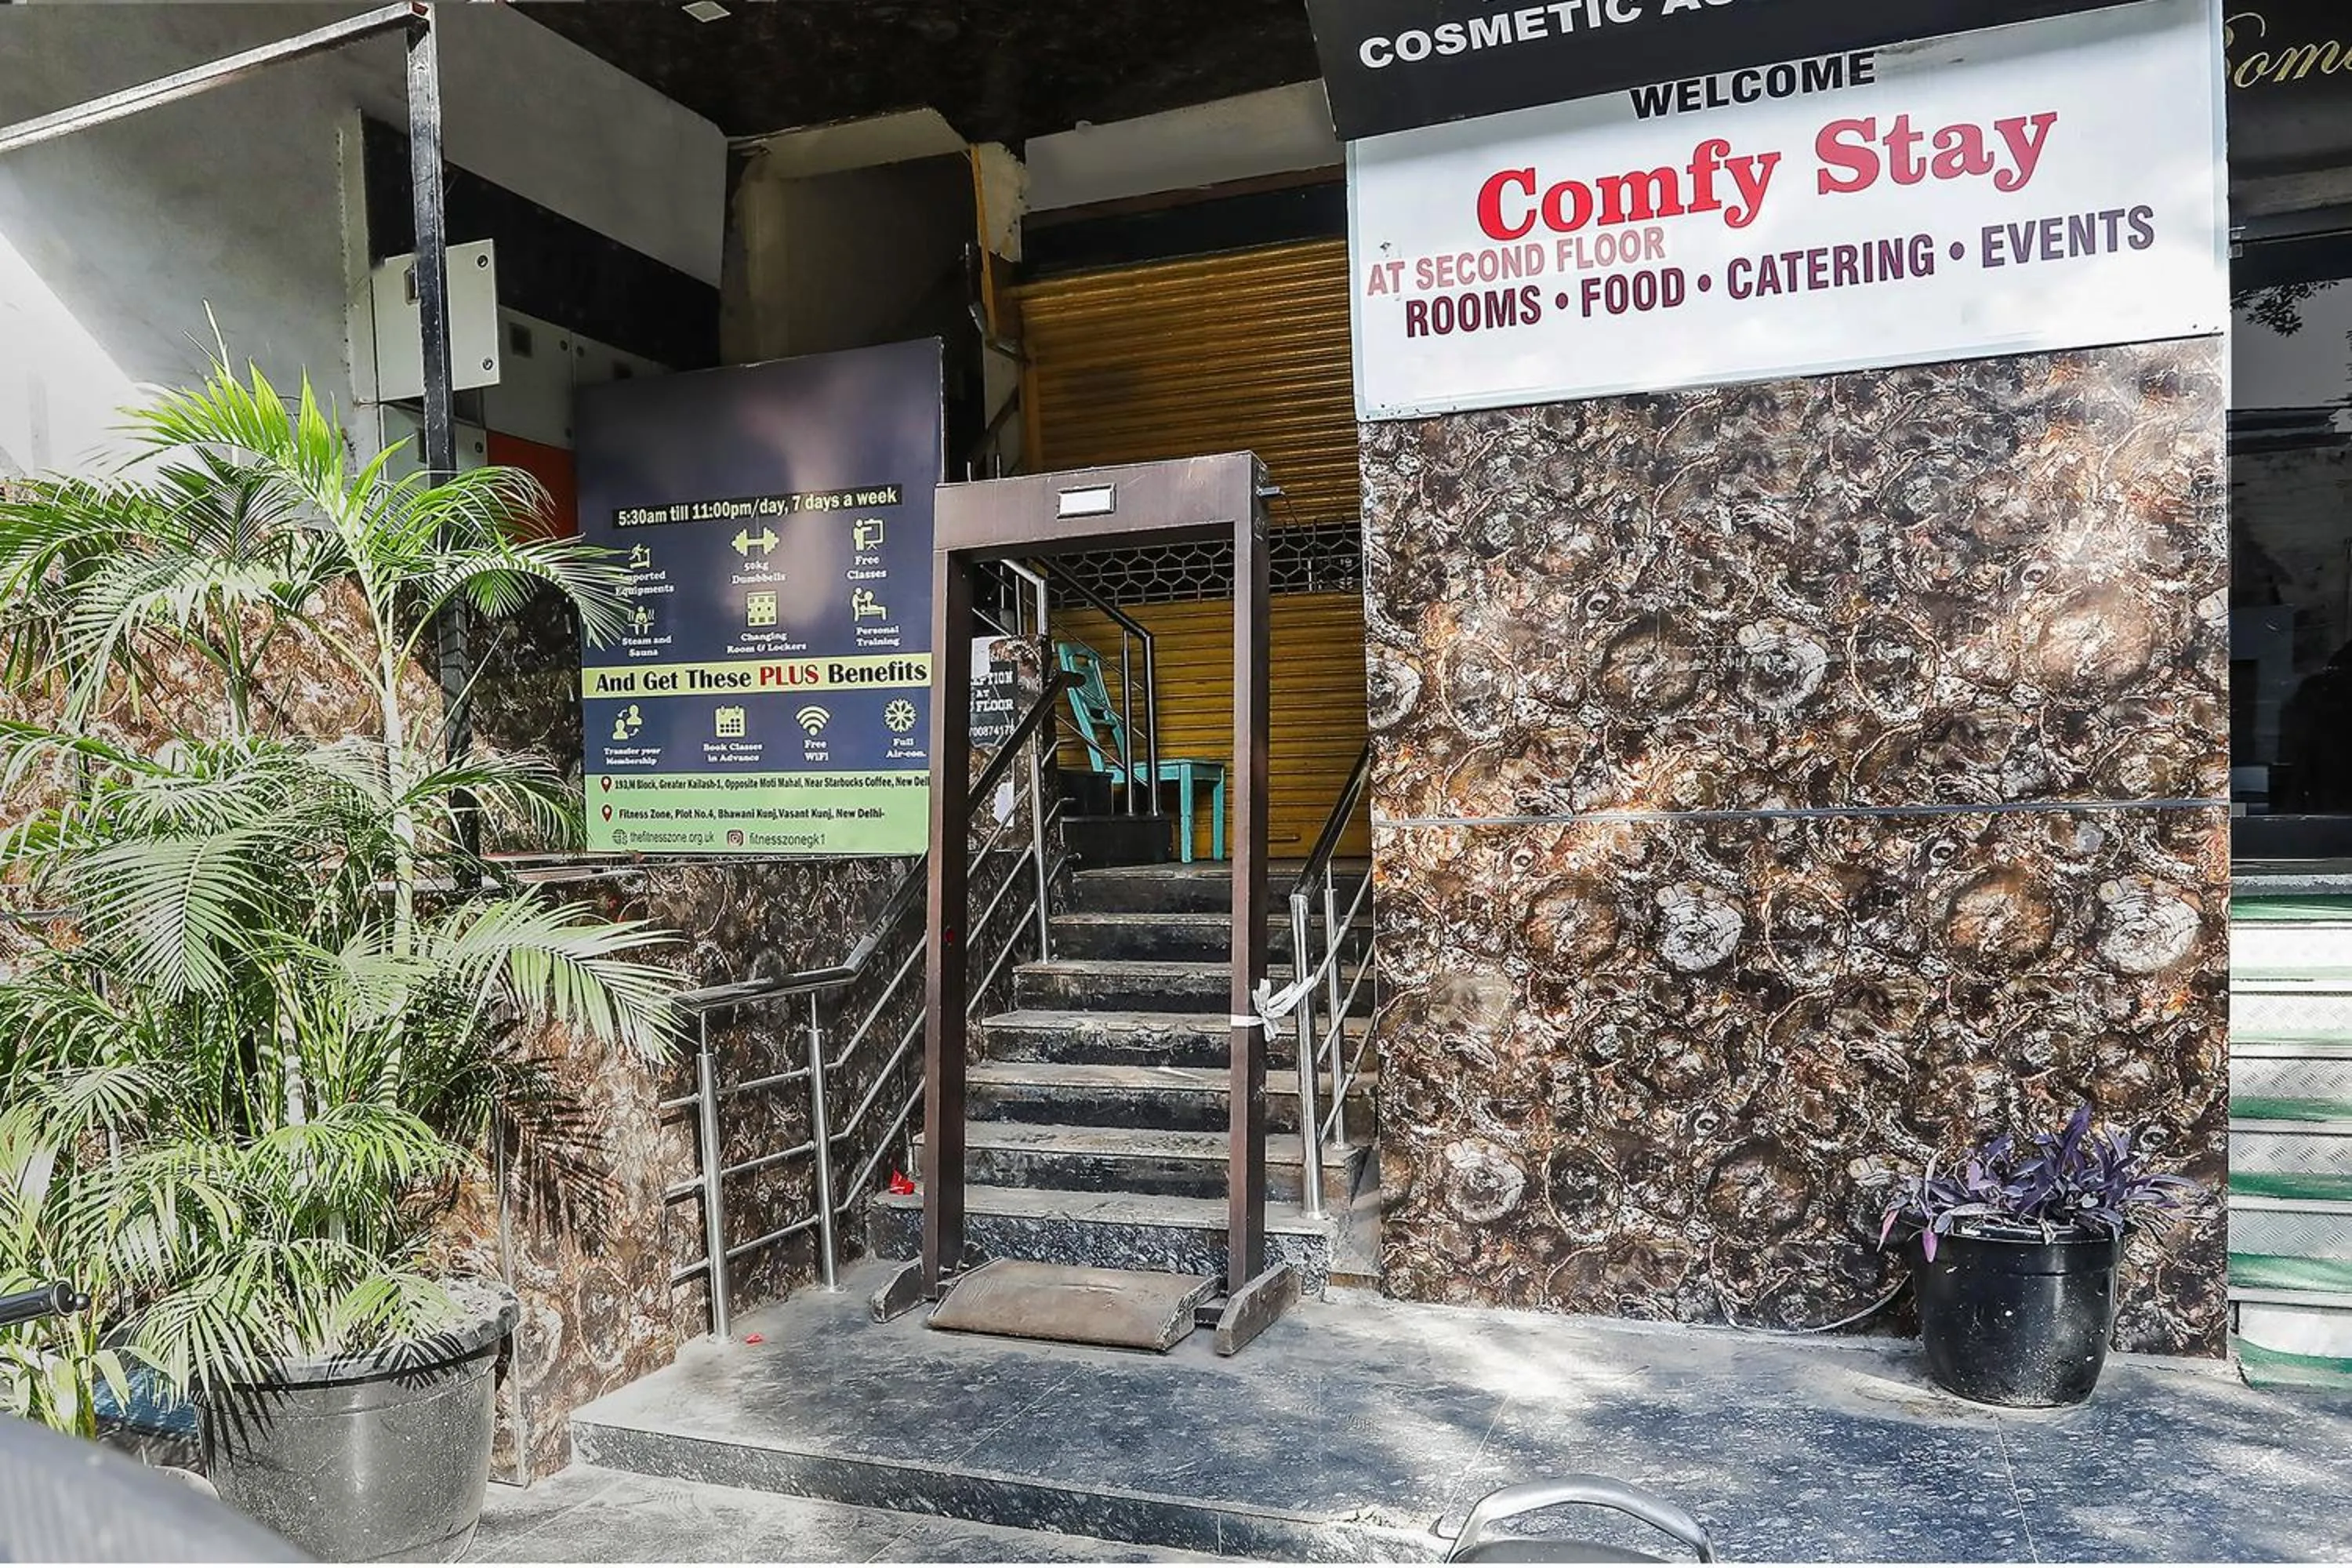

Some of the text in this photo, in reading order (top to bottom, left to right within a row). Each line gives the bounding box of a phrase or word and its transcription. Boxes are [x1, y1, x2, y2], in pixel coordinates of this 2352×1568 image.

[1359, 0, 1642, 68] COSMETIC
[2225, 12, 2352, 88] om
[1630, 51, 1875, 119] WELCOME
[1477, 111, 2057, 241] Comfy Stay
[1367, 227, 1665, 296] AT SECOND FLOOR
[1406, 205, 2154, 337] ROOMS FOOD CATERING EVENTS
[619, 509, 667, 526] 5:30am
[670, 504, 688, 521] till
[793, 495, 800, 510] 7
[804, 494, 839, 511] days
[844, 495, 852, 508] a
[857, 487, 897, 505] week
[855, 555, 880, 564] Free
[620, 570, 666, 584] ported
[731, 572, 786, 583] Dumbbells
[847, 570, 887, 579] Classes
[856, 625, 899, 635] Personal
[654, 635, 672, 644] and
[740, 632, 787, 641] Changing
[856, 637, 901, 647] Training
[629, 648, 659, 657] Sauna
[727, 645, 755, 654] Room
[768, 643, 807, 652] Lockers
[596, 661, 927, 691] And Get These PLUS Benefits
[976, 689, 990, 698] AT
[976, 699, 1014, 713] FLOOR
[804, 739, 827, 749] Free
[892, 738, 913, 746] Full
[606, 757, 657, 766] Membership
[719, 753, 760, 762] Advance
[725, 778, 757, 790] Opposite
[805, 777, 823, 787] Near
[825, 777, 862, 788] Starbucks
[865, 776, 894, 788] Coffee,
[895, 776, 913, 786] New
[619, 809, 648, 819] Fitness
[650, 809, 673, 820] Zone,
[675, 809, 692, 819] Plot
[718, 808, 755, 819] Bhawani
[836, 808, 856, 818] New
